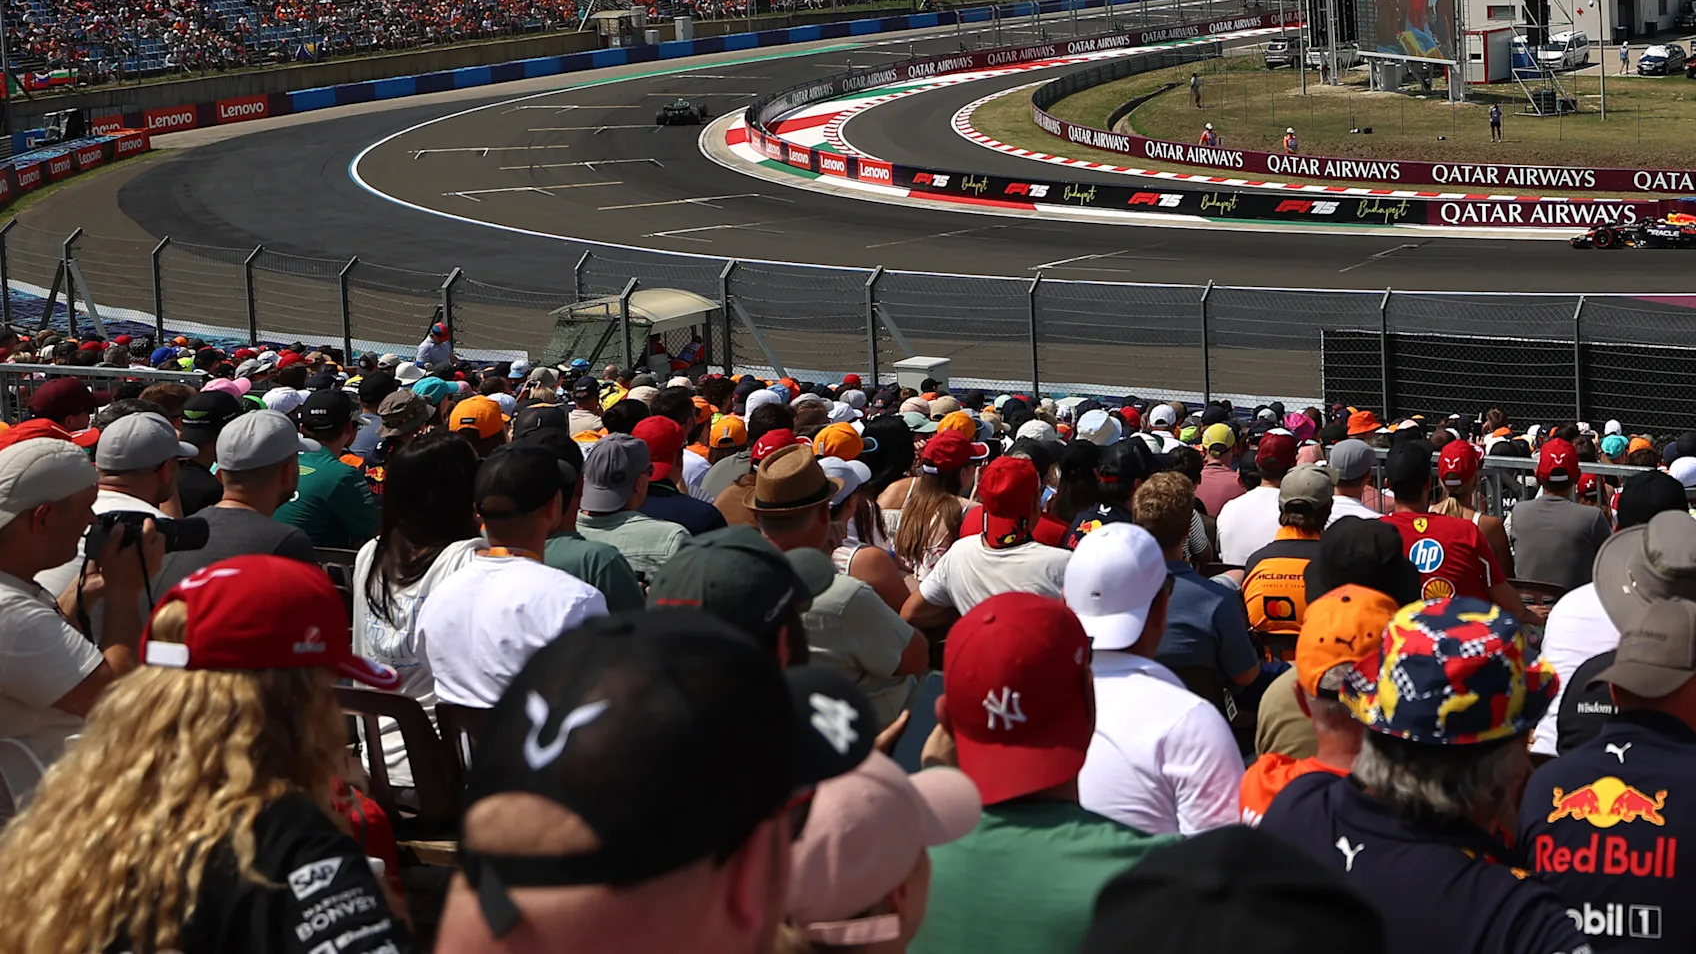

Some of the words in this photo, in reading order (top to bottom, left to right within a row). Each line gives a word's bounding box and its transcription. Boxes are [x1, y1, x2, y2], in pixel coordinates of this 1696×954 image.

[1141, 30, 1167, 43] QATAR
[1168, 25, 1199, 39] AIRWAYS
[1209, 21, 1232, 34] QATAR
[1233, 16, 1261, 30] AIRWAYS
[1067, 40, 1096, 54] QATAR
[1097, 35, 1130, 51] AIRWAYS
[988, 50, 1018, 65] QATAR
[1019, 45, 1055, 60] AIRWAYS
[908, 62, 936, 78] QATAR
[936, 56, 973, 73] AIRWAYS
[842, 75, 866, 91] QATAR
[867, 69, 897, 86] AIRWAYS
[148, 111, 193, 128] Lenovo
[220, 102, 264, 118] Lenovo
[118, 138, 142, 152] Lenovo
[1068, 125, 1092, 143] QATAR
[1092, 131, 1129, 152] AIRWAYS
[78, 151, 101, 165] Lenovo
[789, 148, 809, 164] Lenovo
[1145, 140, 1184, 160] QATAR
[1186, 148, 1243, 168] AIRWAYS
[51, 161, 71, 174] Lenovo
[820, 156, 845, 172] Lenovo
[860, 163, 889, 180] Lenovo
[1267, 155, 1320, 176] QATAR
[1324, 160, 1400, 180] AIRWAYS
[18, 171, 40, 187] Lenovo
[1432, 165, 1499, 184] QATAR
[1505, 168, 1596, 187] AIRWAYS
[1440, 203, 1521, 224] QATAR
[1530, 204, 1635, 225] AIRWAYS
[1416, 539, 1438, 572] hp
[982, 686, 1027, 730] NY
[1534, 832, 1600, 873] Red
[1603, 835, 1677, 878] Bull
[1566, 902, 1623, 936] obil
